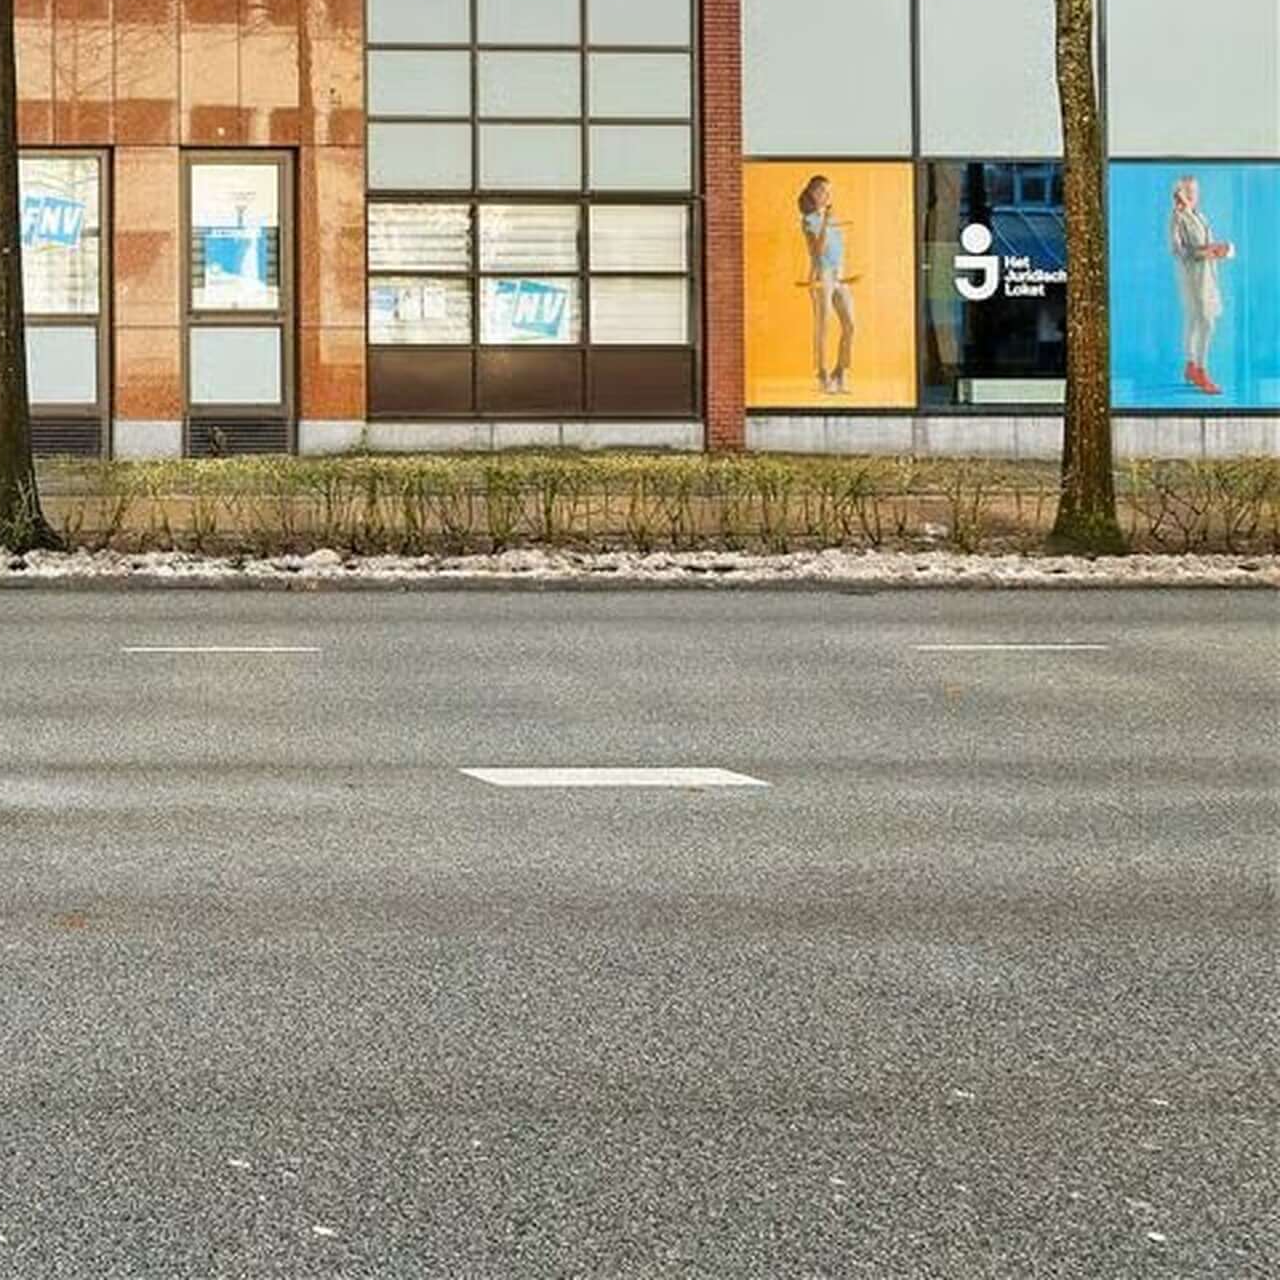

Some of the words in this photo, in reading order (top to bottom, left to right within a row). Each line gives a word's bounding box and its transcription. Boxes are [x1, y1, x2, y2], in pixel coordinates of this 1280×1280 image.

[23, 201, 83, 242] FNV
[1003, 255, 1030, 268] Het
[1003, 282, 1046, 297] Loket
